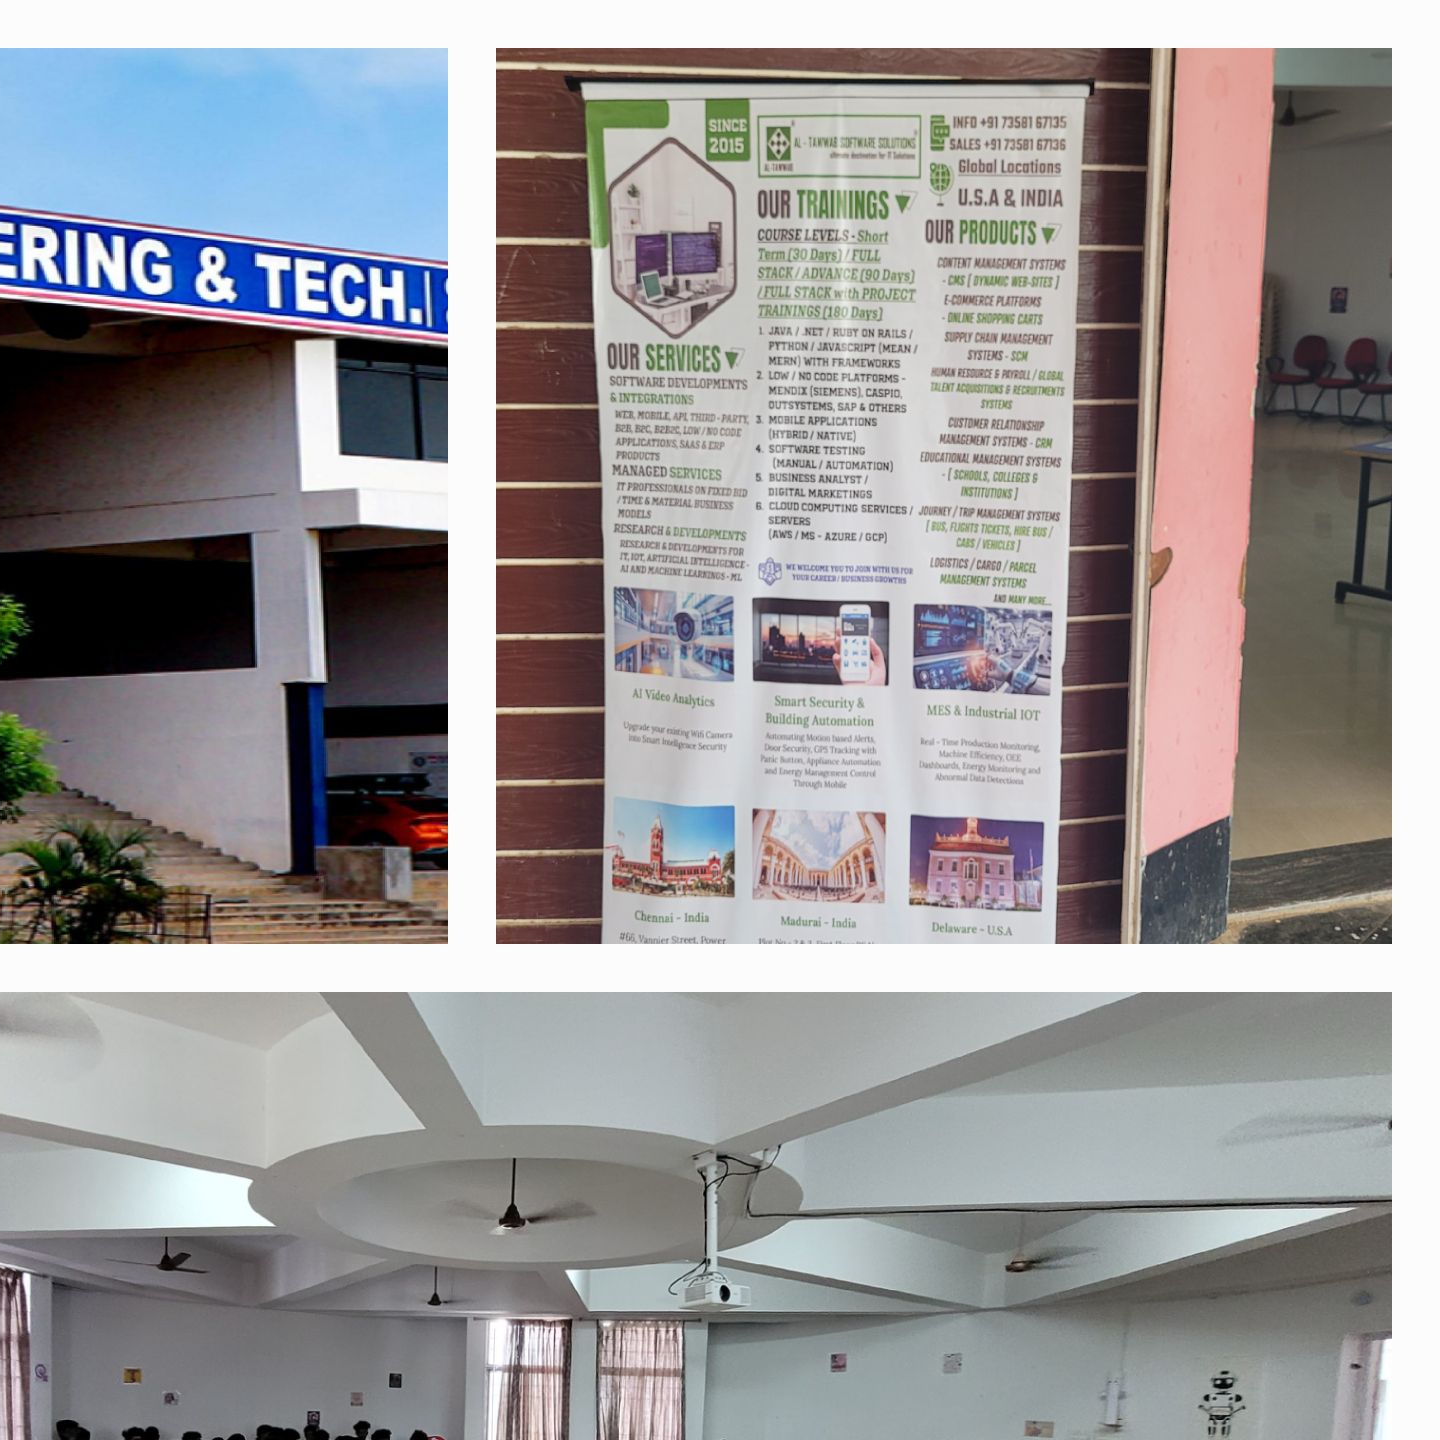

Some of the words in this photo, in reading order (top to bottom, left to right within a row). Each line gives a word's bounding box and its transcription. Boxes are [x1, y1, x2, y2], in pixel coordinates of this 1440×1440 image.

[709, 119, 747, 132] SINCE
[953, 116, 977, 128] INFO
[981, 116, 998, 128] +91
[1002, 116, 1033, 128] 73581
[1036, 116, 1067, 128] 67135
[710, 138, 744, 153] 2015
[950, 139, 981, 150] SALES
[984, 139, 1001, 150] +91
[1004, 139, 1033, 150] 73581
[1037, 139, 1066, 150] 67136
[959, 159, 997, 173] Global
[1001, 160, 1061, 173] Locations
[959, 189, 999, 207] U.S.A
[1004, 189, 1016, 207] &
[1021, 190, 1063, 207] INDIA
[758, 190, 791, 218] OUR
[797, 190, 889, 220] TRAININGS
[758, 229, 802, 241] COURSE
[805, 230, 848, 241] LEVELS
[857, 231, 889, 243] Short
[926, 220, 954, 244] OUR
[959, 220, 1036, 245] PRODUCTS
[758, 249, 785, 260] Term
[852, 250, 881, 261] FULL
[937, 257, 972, 268] CONTENT
[974, 258, 1027, 270] MANAGEMENT
[1029, 259, 1066, 271] SYSTEMS
[758, 267, 793, 279] STACK
[802, 268, 858, 280] ADVANCE
[194, 246, 238, 304] &
[254, 252, 422, 326] TECH.
[764, 286, 791, 297] FULL
[794, 286, 832, 298] STACK
[834, 288, 859, 299] with
[862, 288, 916, 300] PROJECT
[996, 296, 1042, 307] PLATFORMS
[758, 304, 821, 317] TRAININGS
[948, 312, 974, 323] ONLINE
[976, 313, 1015, 324] SHOPPING
[1017, 314, 1043, 325] CARTS
[833, 328, 859, 337] RUBY
[862, 329, 875, 338] ON
[878, 329, 907, 339] RAILS
[769, 341, 809, 351] PYTHON
[817, 342, 876, 352] JAVASCRIPT
[608, 343, 640, 370] OUR
[645, 344, 721, 372] SERVICES
[804, 357, 829, 367] WITH
[832, 358, 901, 368] FRAMEWORKS
[610, 376, 665, 387] SOFTWARE
[668, 378, 748, 390] DEVELOPMENTS
[769, 371, 789, 380] LOW
[798, 372, 811, 381] NO
[814, 373, 839, 381] CODE
[842, 373, 899, 383] PLATFORMS
[769, 386, 807, 395] MENDIX
[610, 393, 616, 403] &
[619, 393, 694, 405] INTEGRATIONS
[837, 402, 857, 411] SAP
[869, 403, 907, 413] OTHERS
[769, 416, 805, 425] MOBILE
[808, 416, 877, 426] APPLICATIONS
[769, 445, 821, 454] SOFTWARE
[823, 446, 866, 456] TESTING
[612, 464, 668, 478] MANAGED
[670, 467, 722, 480] SERVICES
[769, 473, 816, 483] BUSINESS
[818, 475, 862, 484] ANALYST
[769, 488, 805, 497] DIGITAL
[808, 489, 872, 499] MARKETINGS
[769, 502, 799, 511] CLOUD
[801, 503, 858, 513] COMPUTING
[861, 505, 907, 515] SERVICES
[614, 524, 664, 534] RESEARCH
[674, 528, 747, 541] DEVELOPMENTS
[645, 689, 670, 702] Video
[673, 693, 715, 709] Analytics
[775, 695, 806, 707] Smart
[810, 696, 854, 712] Security
[857, 698, 864, 708] &
[927, 705, 951, 716] MES
[953, 705, 961, 716] &
[965, 706, 1017, 720] Industrial
[1021, 709, 1040, 721] IOT
[766, 713, 809, 728] Building
[812, 715, 874, 727] Automation
[635, 910, 673, 923] Chennai
[684, 912, 709, 923] India
[781, 916, 821, 927] Madurai
[832, 918, 857, 928] India
[932, 922, 977, 934] Delaware
